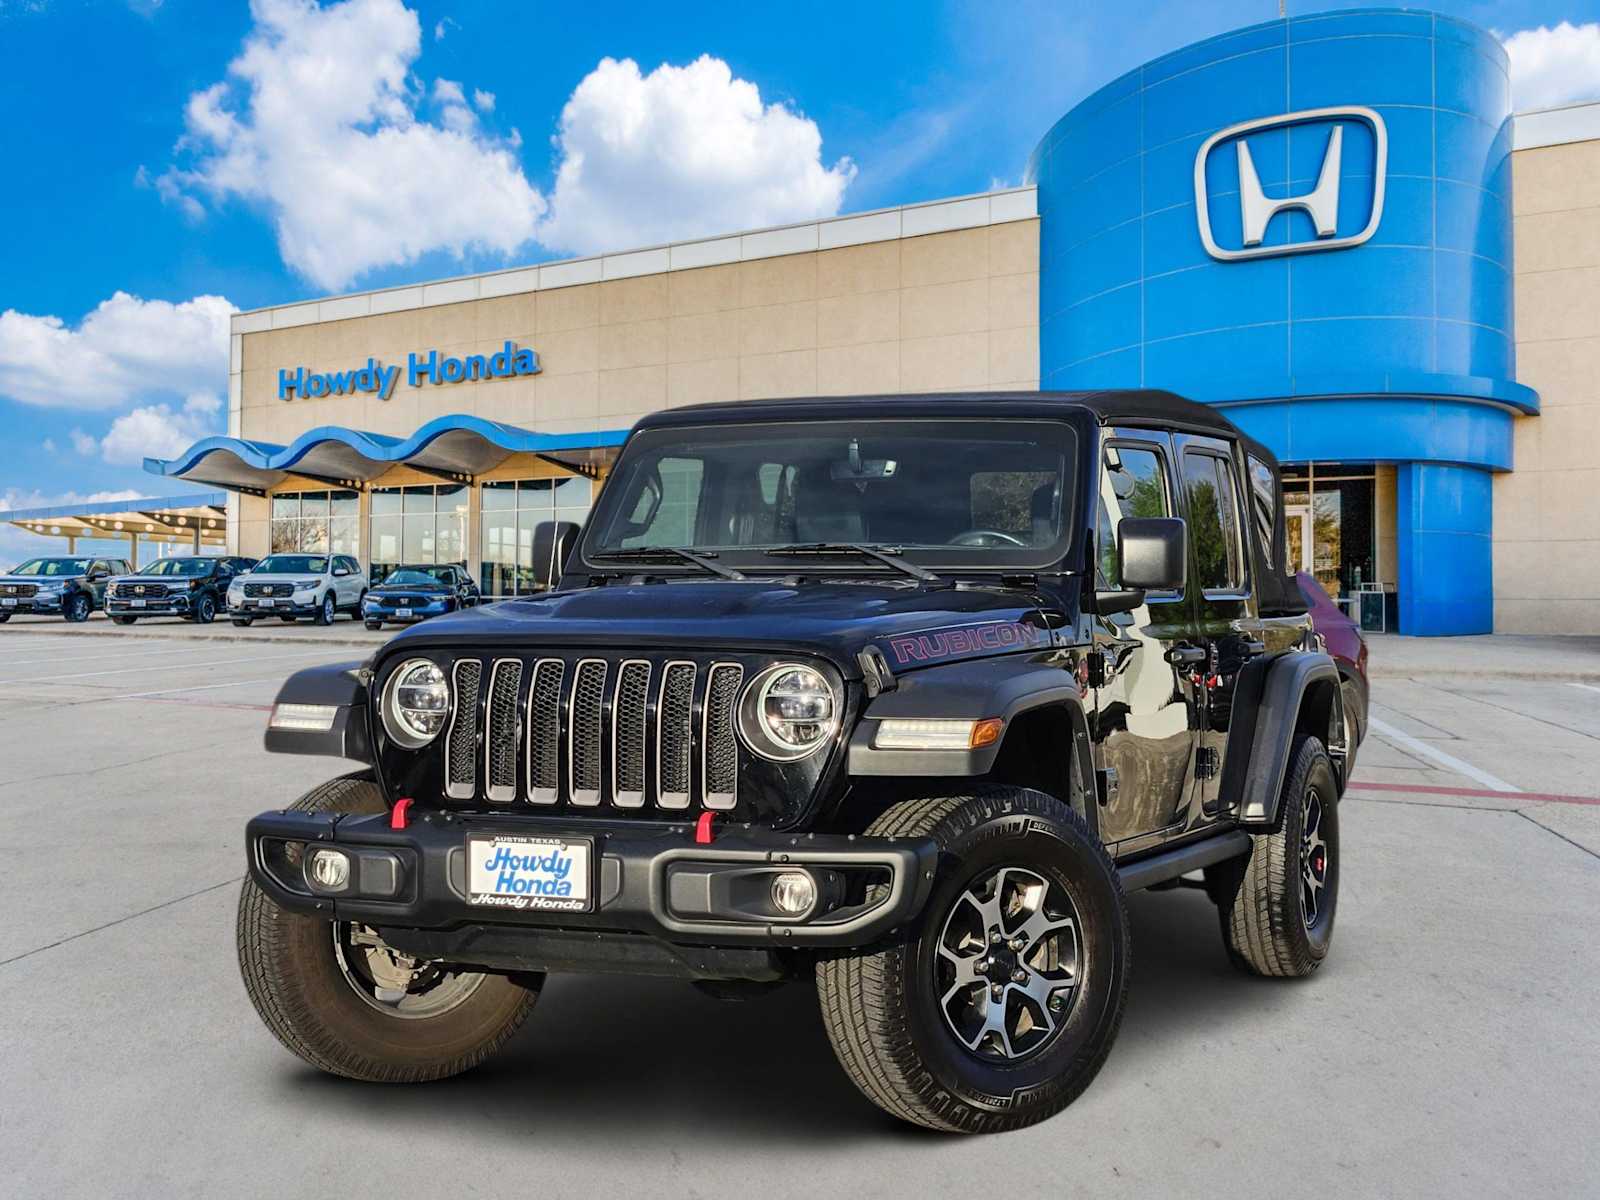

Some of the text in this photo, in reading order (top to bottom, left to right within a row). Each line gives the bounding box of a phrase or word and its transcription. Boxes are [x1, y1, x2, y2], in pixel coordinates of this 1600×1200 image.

[278, 340, 542, 400] Howdy Honda
[890, 621, 1040, 664] RUBICON
[494, 836, 561, 845] AUSTIN TEXAS
[485, 847, 572, 879] Howdy
[495, 871, 572, 896] Honda
[471, 894, 585, 910] Howdy Honda
